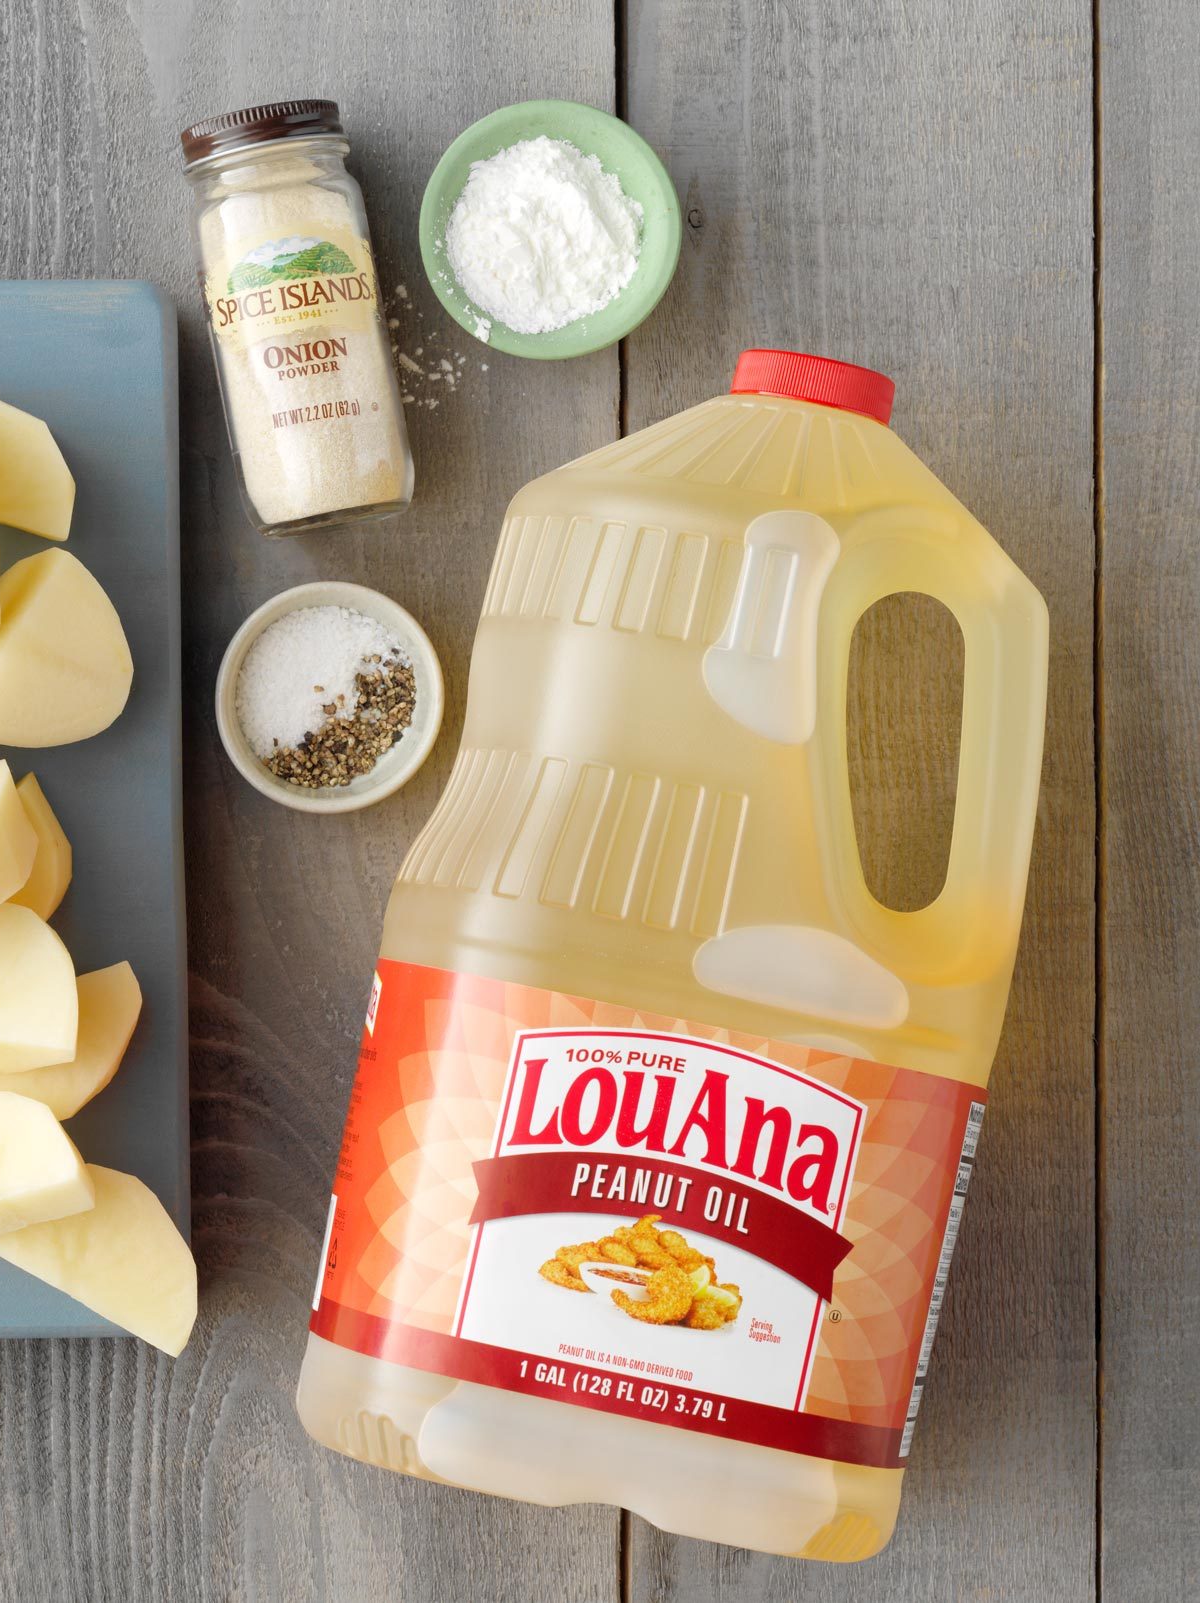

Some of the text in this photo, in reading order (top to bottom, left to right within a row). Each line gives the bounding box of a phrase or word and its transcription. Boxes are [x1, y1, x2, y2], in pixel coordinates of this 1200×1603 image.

[216, 272, 371, 327] SPICE ISLANDS
[273, 309, 322, 325] EST. 1941
[262, 337, 348, 369] ONION
[278, 361, 341, 381] POWDER
[272, 411, 288, 429] NET
[289, 408, 304, 425] WT
[305, 405, 321, 422] 2.2
[322, 402, 334, 419] OZ
[335, 400, 350, 418] (62
[565, 1048, 687, 1074] 100% PURE
[570, 1163, 749, 1235] PEANUT OIL
[748, 1327, 782, 1344] Suggestion
[751, 1317, 774, 1334] Serving
[558, 1343, 694, 1382] PEANUT OIL IS A NON-GMO DERIVED FOOD
[520, 1360, 727, 1422] 1 GAL (128 FL OZ) 3.79 L
